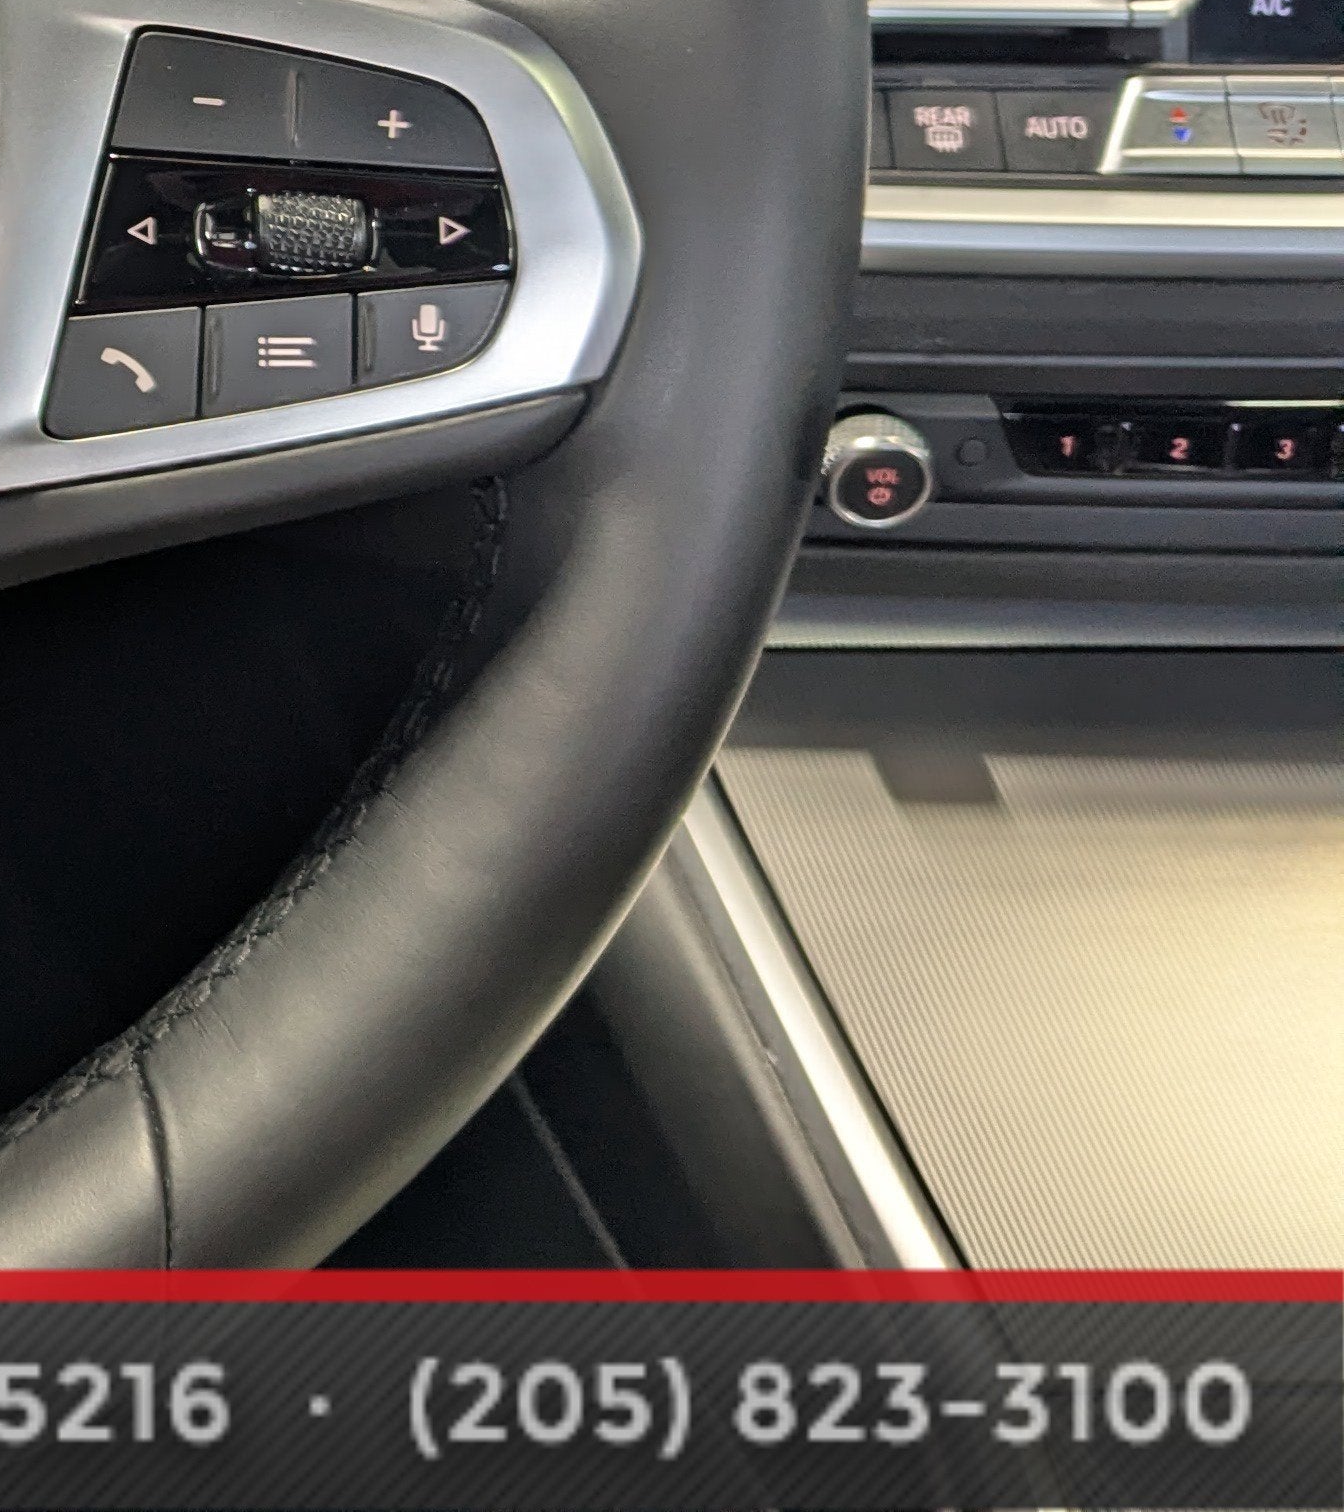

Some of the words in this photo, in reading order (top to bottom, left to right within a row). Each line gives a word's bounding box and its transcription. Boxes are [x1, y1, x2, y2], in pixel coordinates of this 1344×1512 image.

[914, 106, 970, 128] REAR
[1025, 118, 1088, 140] AUTO
[1060, 435, 1076, 457] 1
[1170, 437, 1189, 460] 2
[1275, 439, 1295, 460] 3
